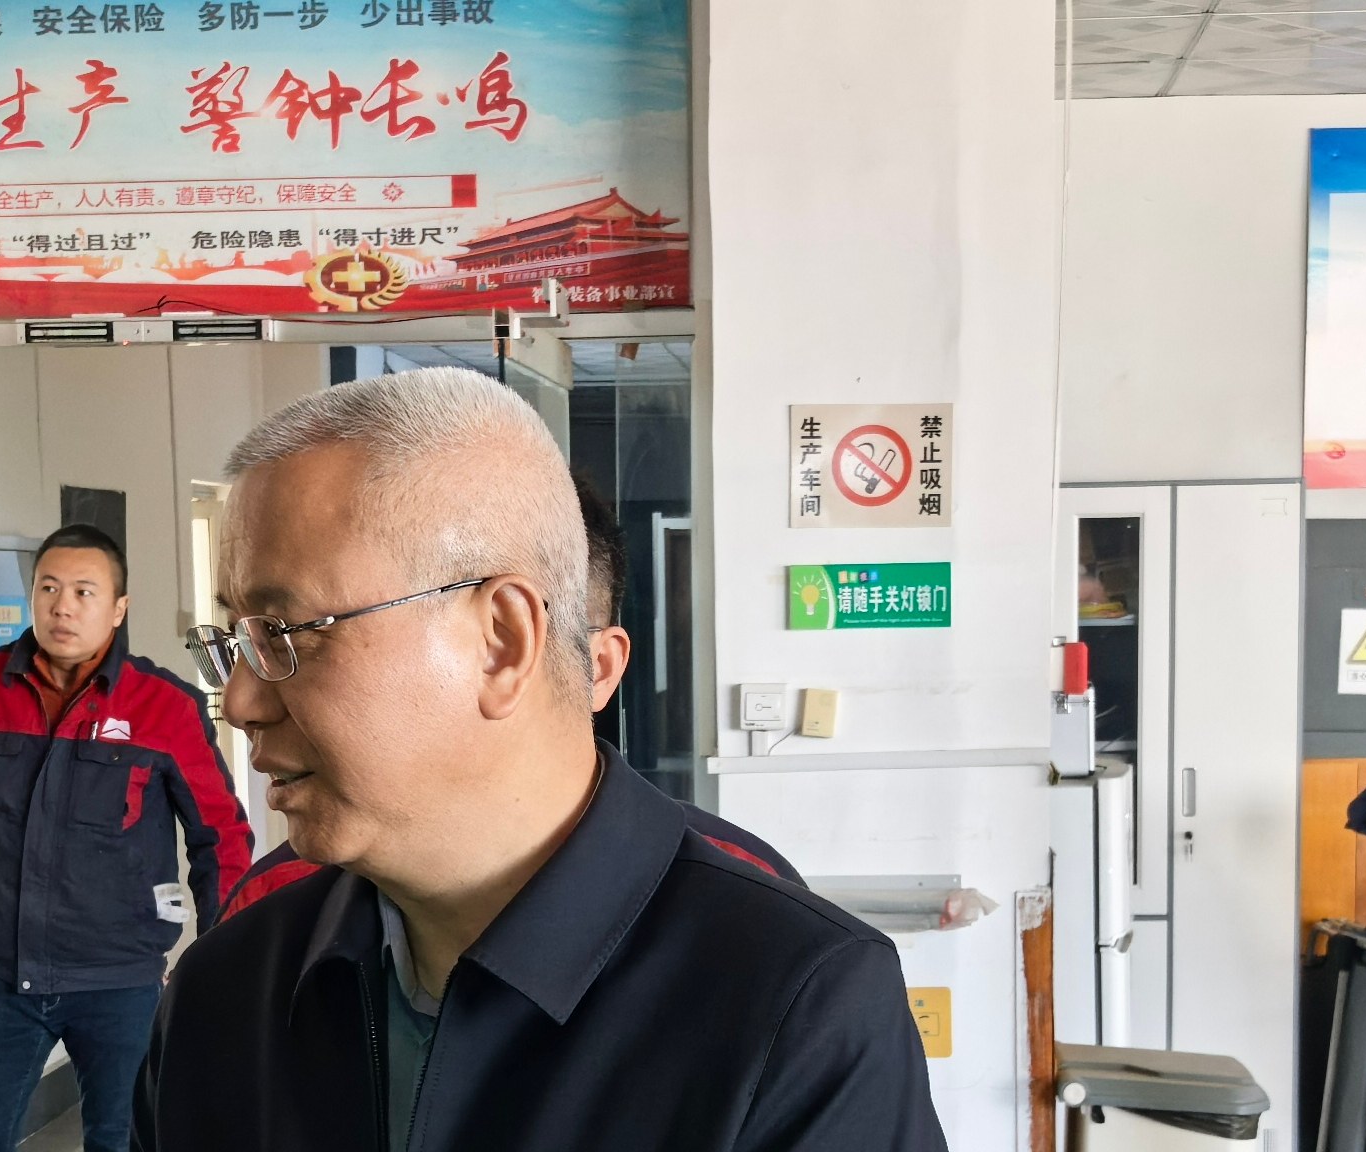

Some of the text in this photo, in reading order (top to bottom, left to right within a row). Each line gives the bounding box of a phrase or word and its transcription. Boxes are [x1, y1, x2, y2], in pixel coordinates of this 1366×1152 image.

[32, 3, 165, 35] 安全保险
[198, 1, 329, 32] 多防一步
[360, 0, 495, 28] 少出事故
[180, 51, 528, 154] 警钟长鸣
[800, 416, 823, 517] 生产车间
[919, 415, 943, 517] 禁止吸烟
[838, 585, 947, 613] 请随手关灯锁门
